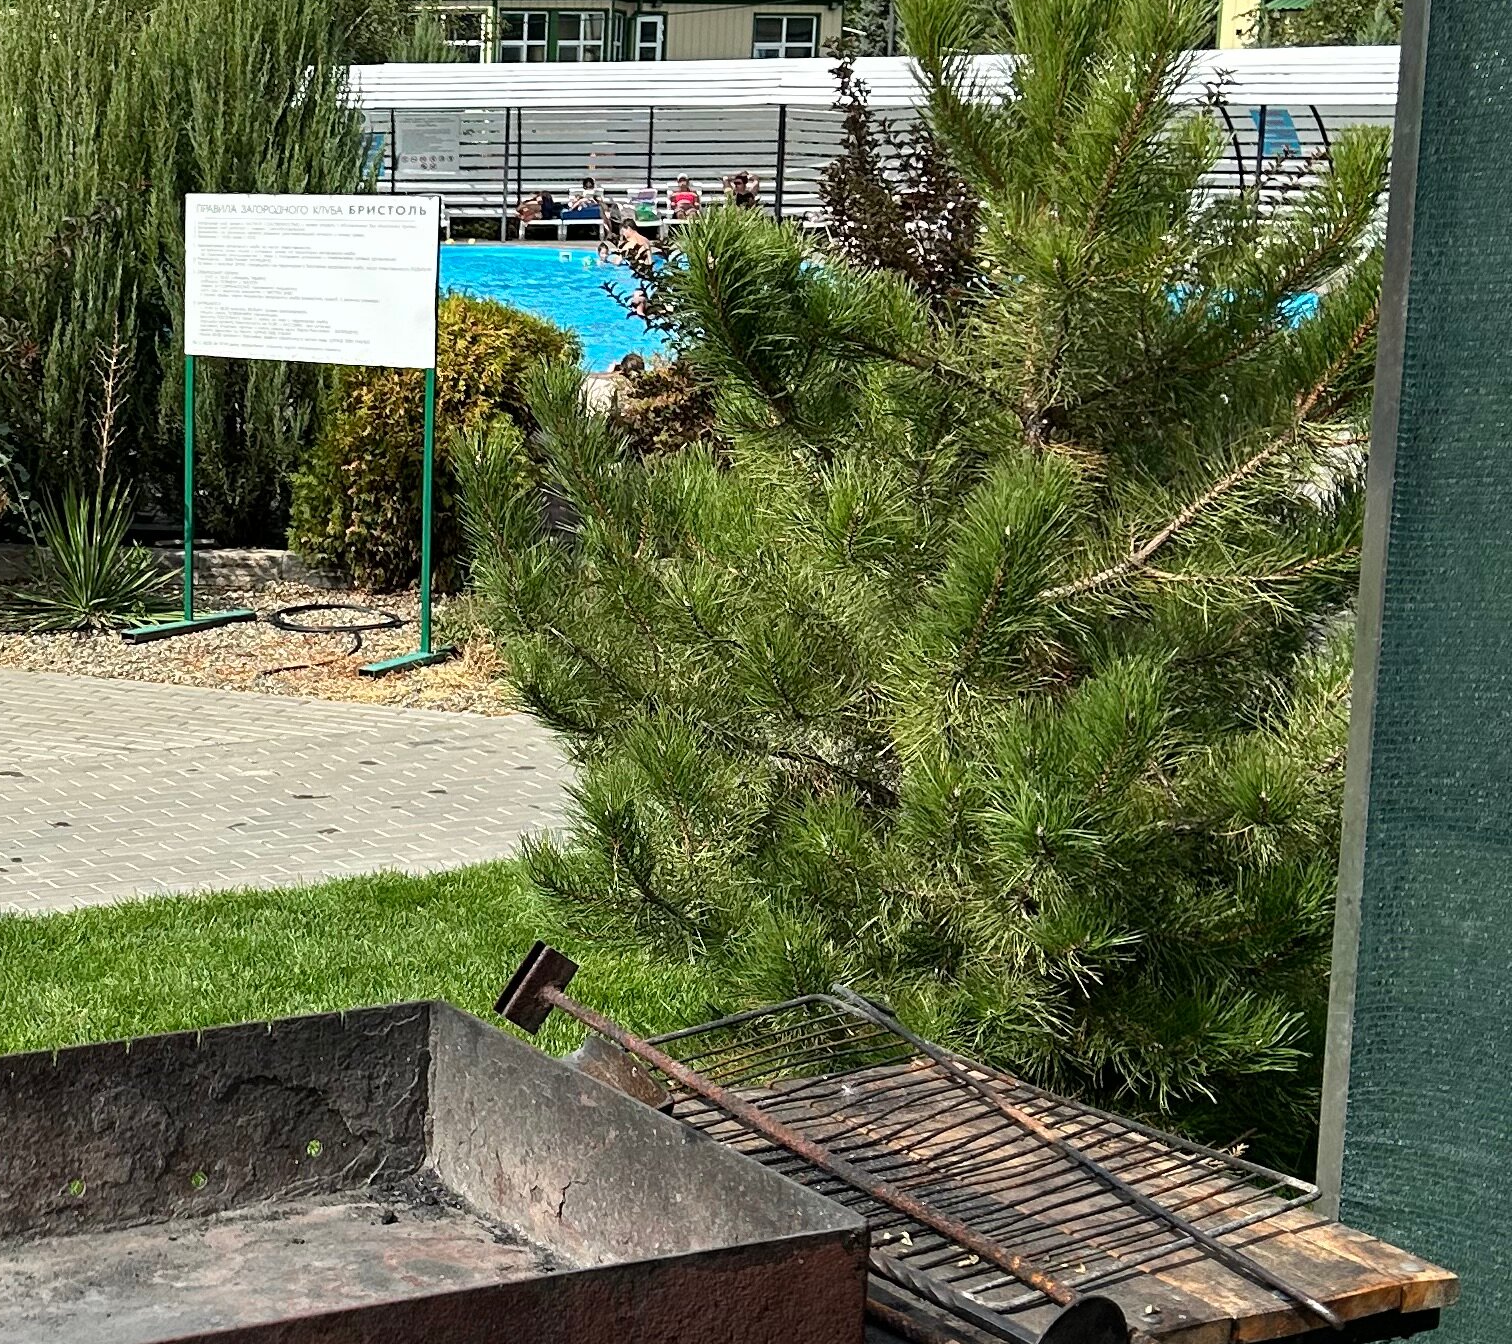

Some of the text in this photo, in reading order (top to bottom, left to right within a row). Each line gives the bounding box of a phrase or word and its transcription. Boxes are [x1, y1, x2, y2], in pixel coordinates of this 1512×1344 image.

[196, 203, 427, 216] ПРАВИЛА ЗАГОРОДНОГО КЛУБА БРИСТОЛЬ
